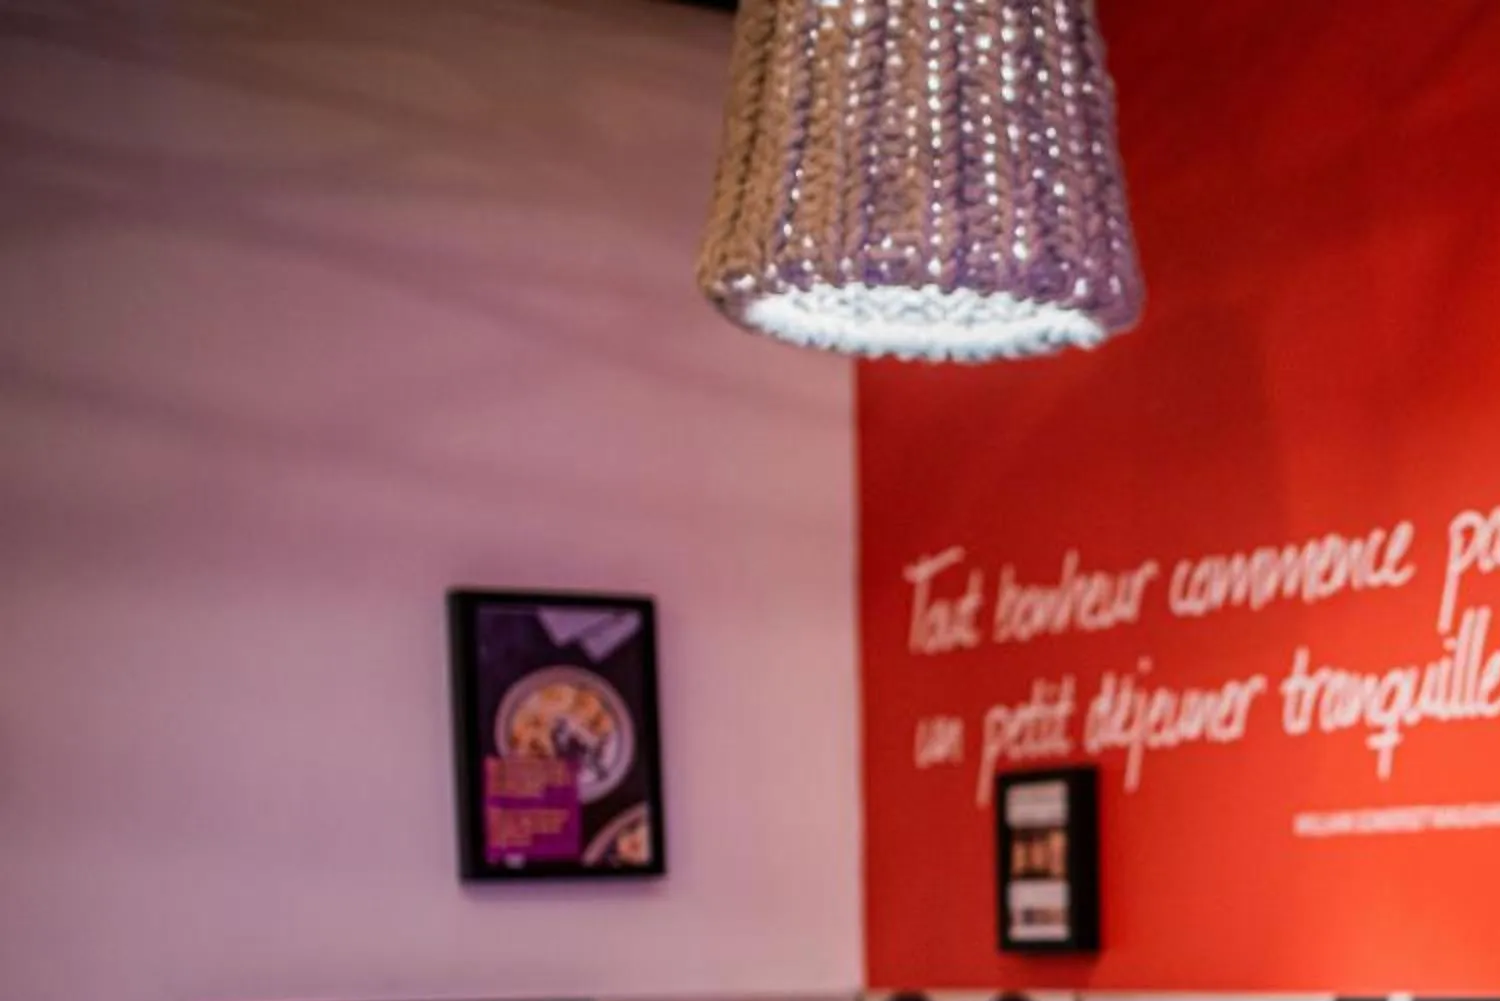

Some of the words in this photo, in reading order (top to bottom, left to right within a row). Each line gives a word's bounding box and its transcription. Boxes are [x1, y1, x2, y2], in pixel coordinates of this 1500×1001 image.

[904, 545, 984, 655] Tout
[993, 549, 1159, 643] bonheur
[1168, 520, 1415, 617] commence
[914, 715, 965, 769] un
[976, 674, 1076, 808] petit
